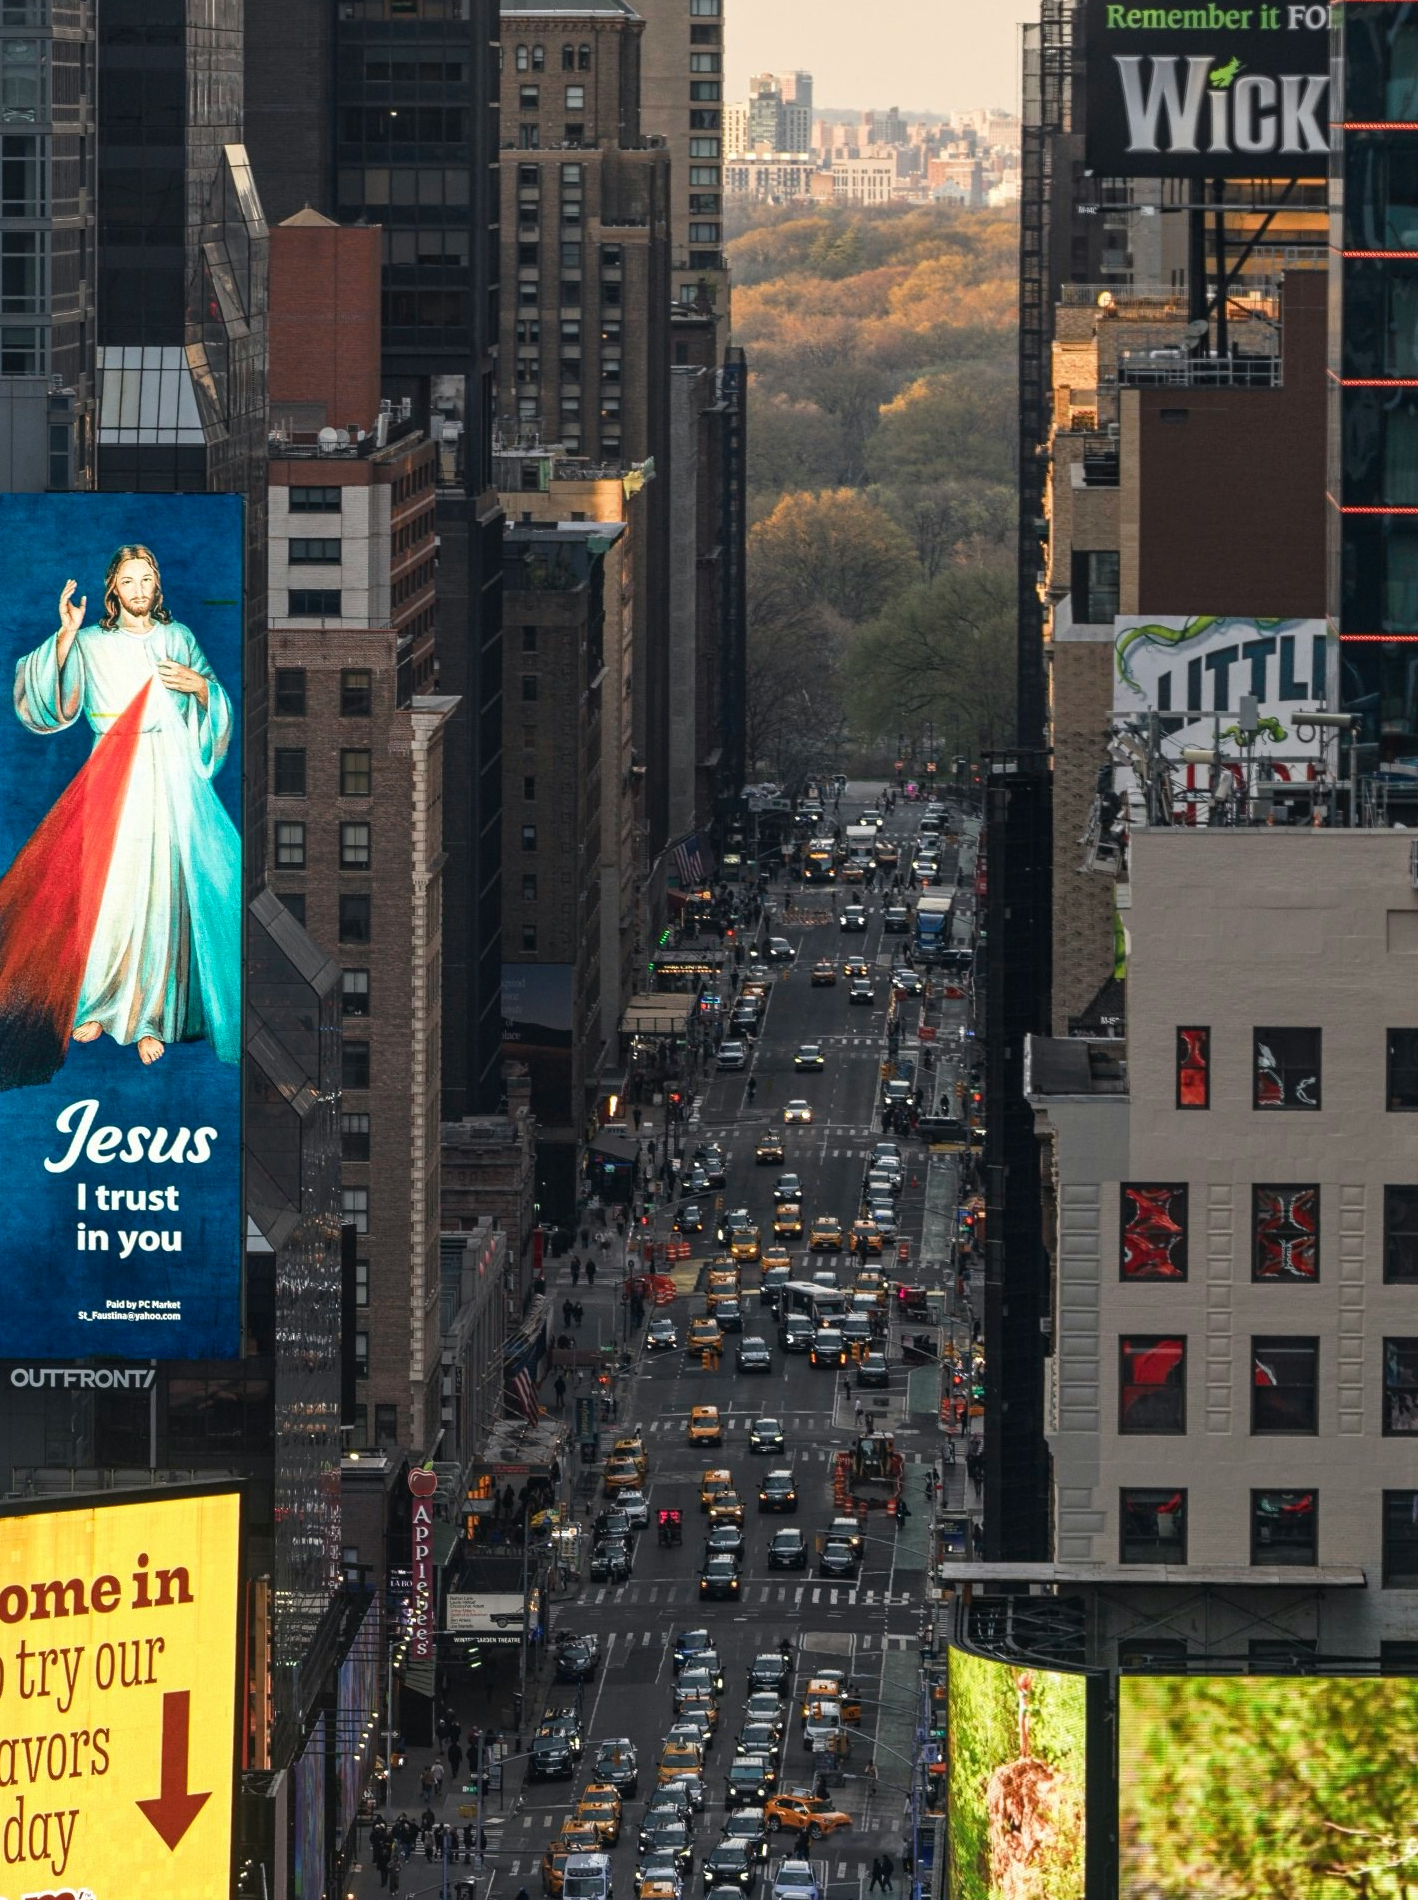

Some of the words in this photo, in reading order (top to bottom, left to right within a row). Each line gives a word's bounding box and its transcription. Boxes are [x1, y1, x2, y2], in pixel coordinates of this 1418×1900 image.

[1106, 5, 1254, 30] Remember
[1260, 5, 1281, 29] it
[44, 1099, 218, 1174] Jesus
[78, 1183, 86, 1211] I
[95, 1186, 180, 1211] trust
[77, 1223, 108, 1251] in
[118, 1230, 182, 1260] you
[106, 1300, 125, 1309] Paid
[126, 1300, 137, 1312] by
[139, 1300, 151, 1309] PC
[152, 1300, 181, 1309] Market
[132, 1554, 194, 1609] in
[16, 1638, 83, 1713] try
[96, 1637, 165, 1691] our
